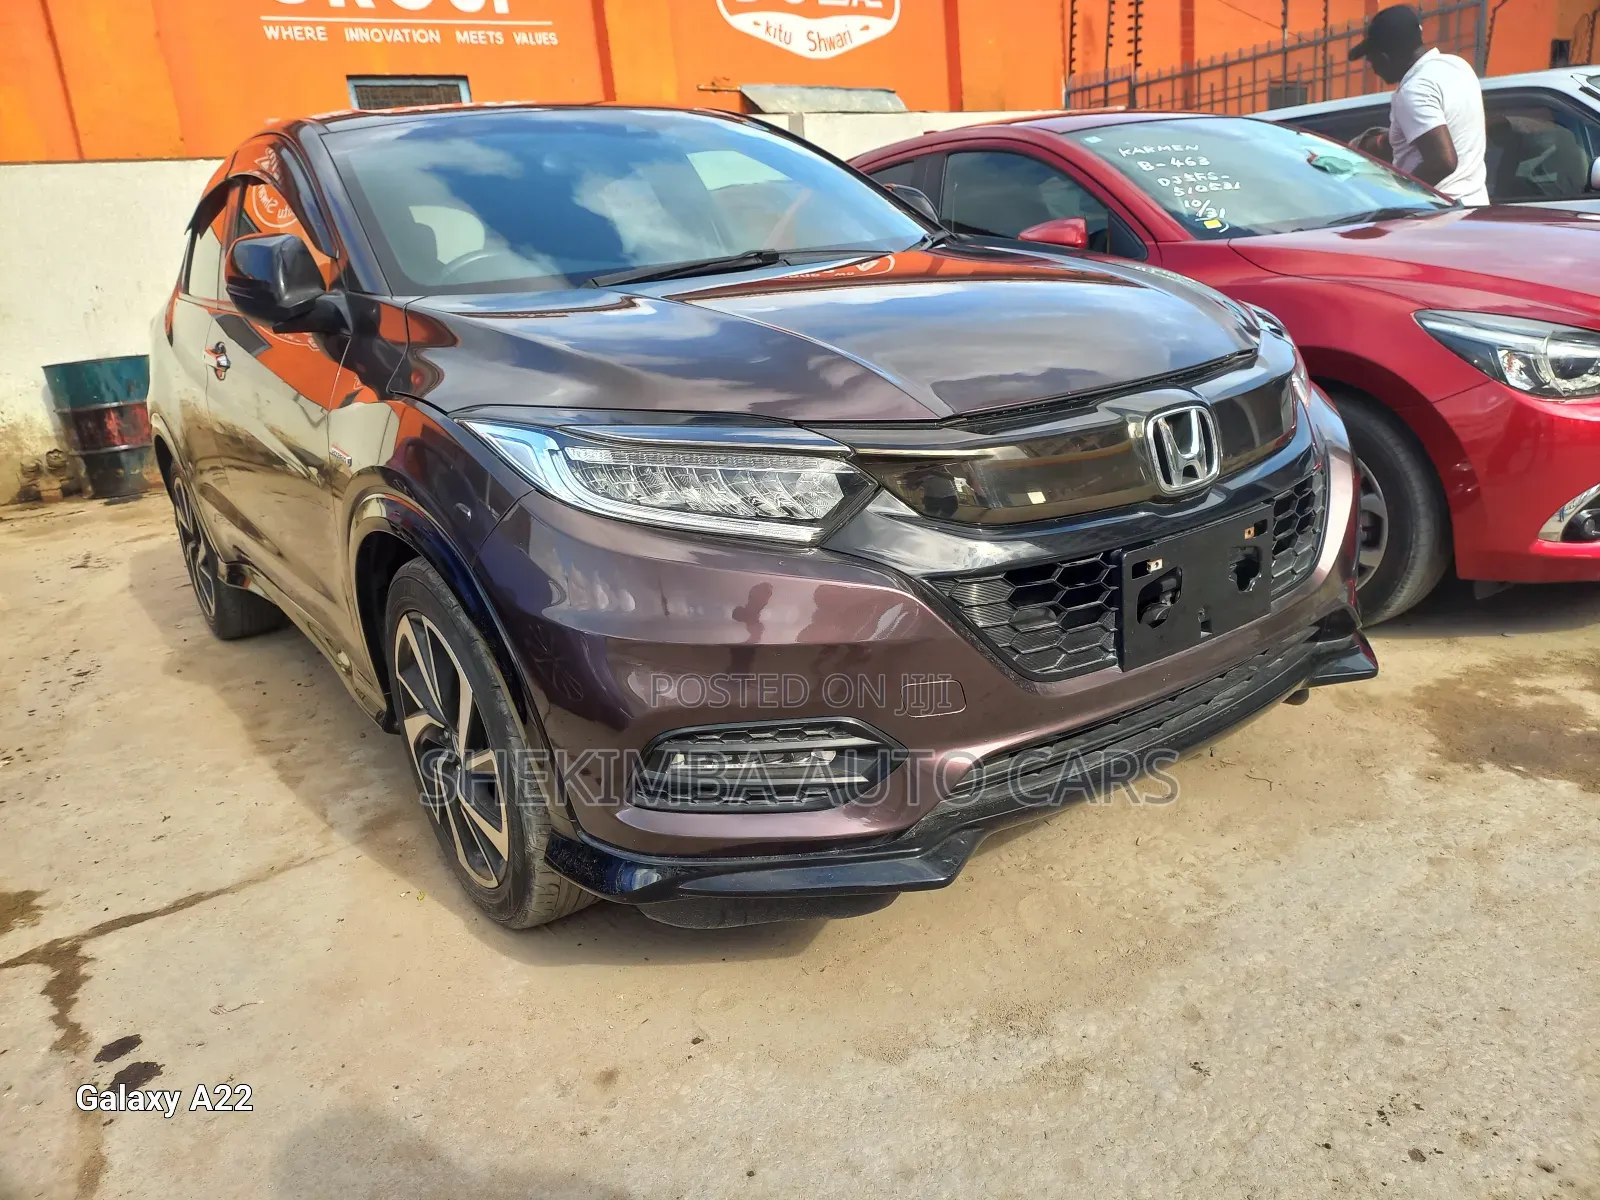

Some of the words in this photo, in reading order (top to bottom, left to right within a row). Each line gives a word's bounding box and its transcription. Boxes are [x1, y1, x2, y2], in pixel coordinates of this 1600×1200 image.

[263, 25, 328, 42] WHERE
[344, 27, 440, 44] INNOVATION
[455, 30, 504, 45] MEETS
[513, 32, 558, 46] VALUES
[765, 20, 792, 45] kitu
[806, 24, 852, 51] Shwari
